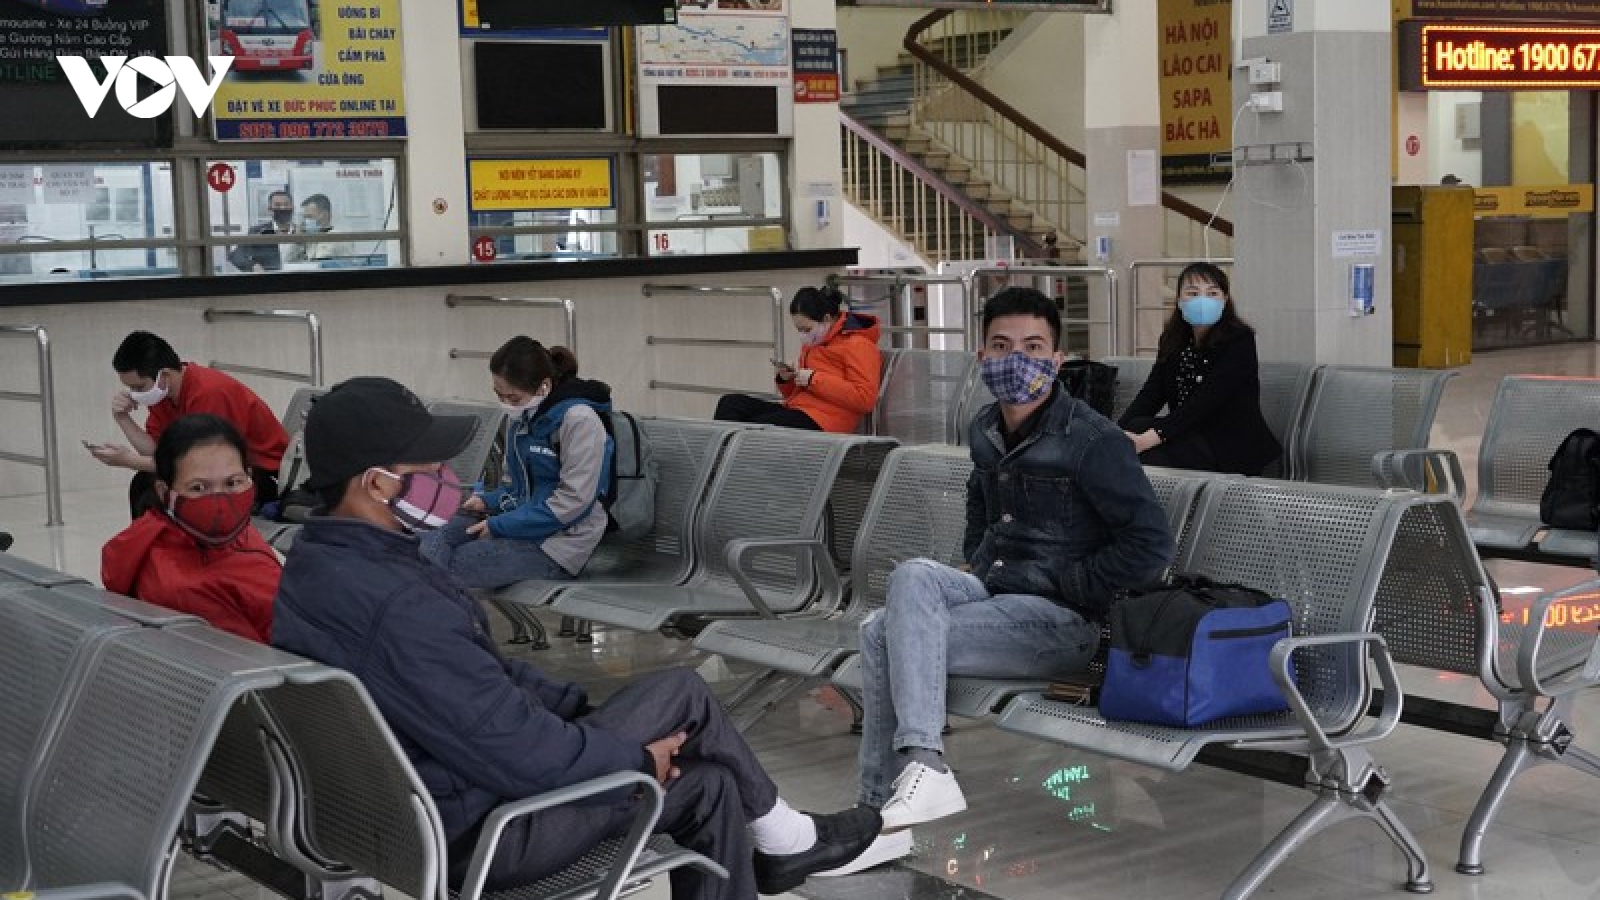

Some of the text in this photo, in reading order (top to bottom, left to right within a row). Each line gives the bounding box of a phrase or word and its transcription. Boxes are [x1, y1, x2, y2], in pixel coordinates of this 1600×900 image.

[129, 19, 149, 30] VIP
[1165, 17, 1219, 46] HÀ NỘI
[84, 33, 106, 44] Cao
[1163, 54, 1223, 77] LÀO CAI
[1435, 40, 1515, 71] Hotline:
[1518, 41, 1569, 71] 1900
[1173, 87, 1212, 109] SAPA
[1198, 115, 1221, 141] HÀ
[211, 170, 232, 184] 14
[476, 241, 494, 256] 15
